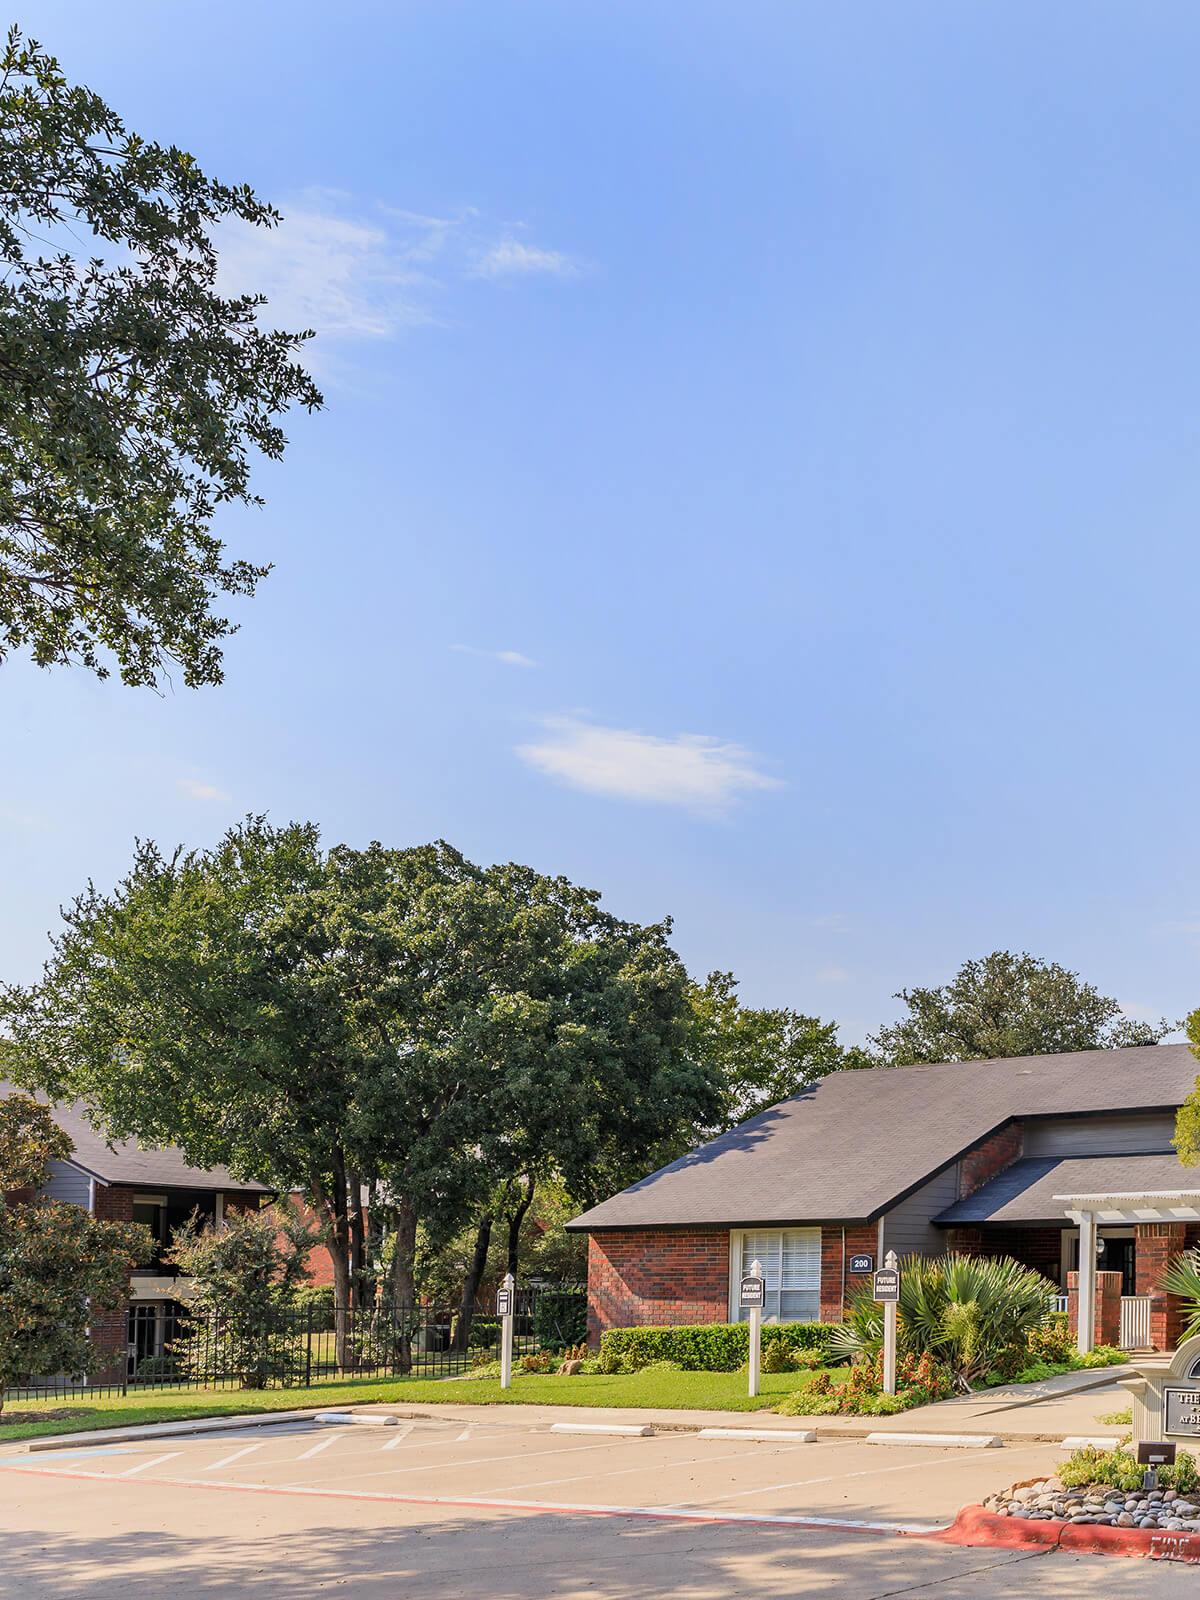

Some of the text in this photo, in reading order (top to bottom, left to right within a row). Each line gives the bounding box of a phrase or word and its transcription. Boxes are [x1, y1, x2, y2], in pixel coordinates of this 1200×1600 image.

[854, 1259, 868, 1268] 200
[1177, 1393, 1200, 1404] THE
[1179, 1416, 1190, 1424] AT
